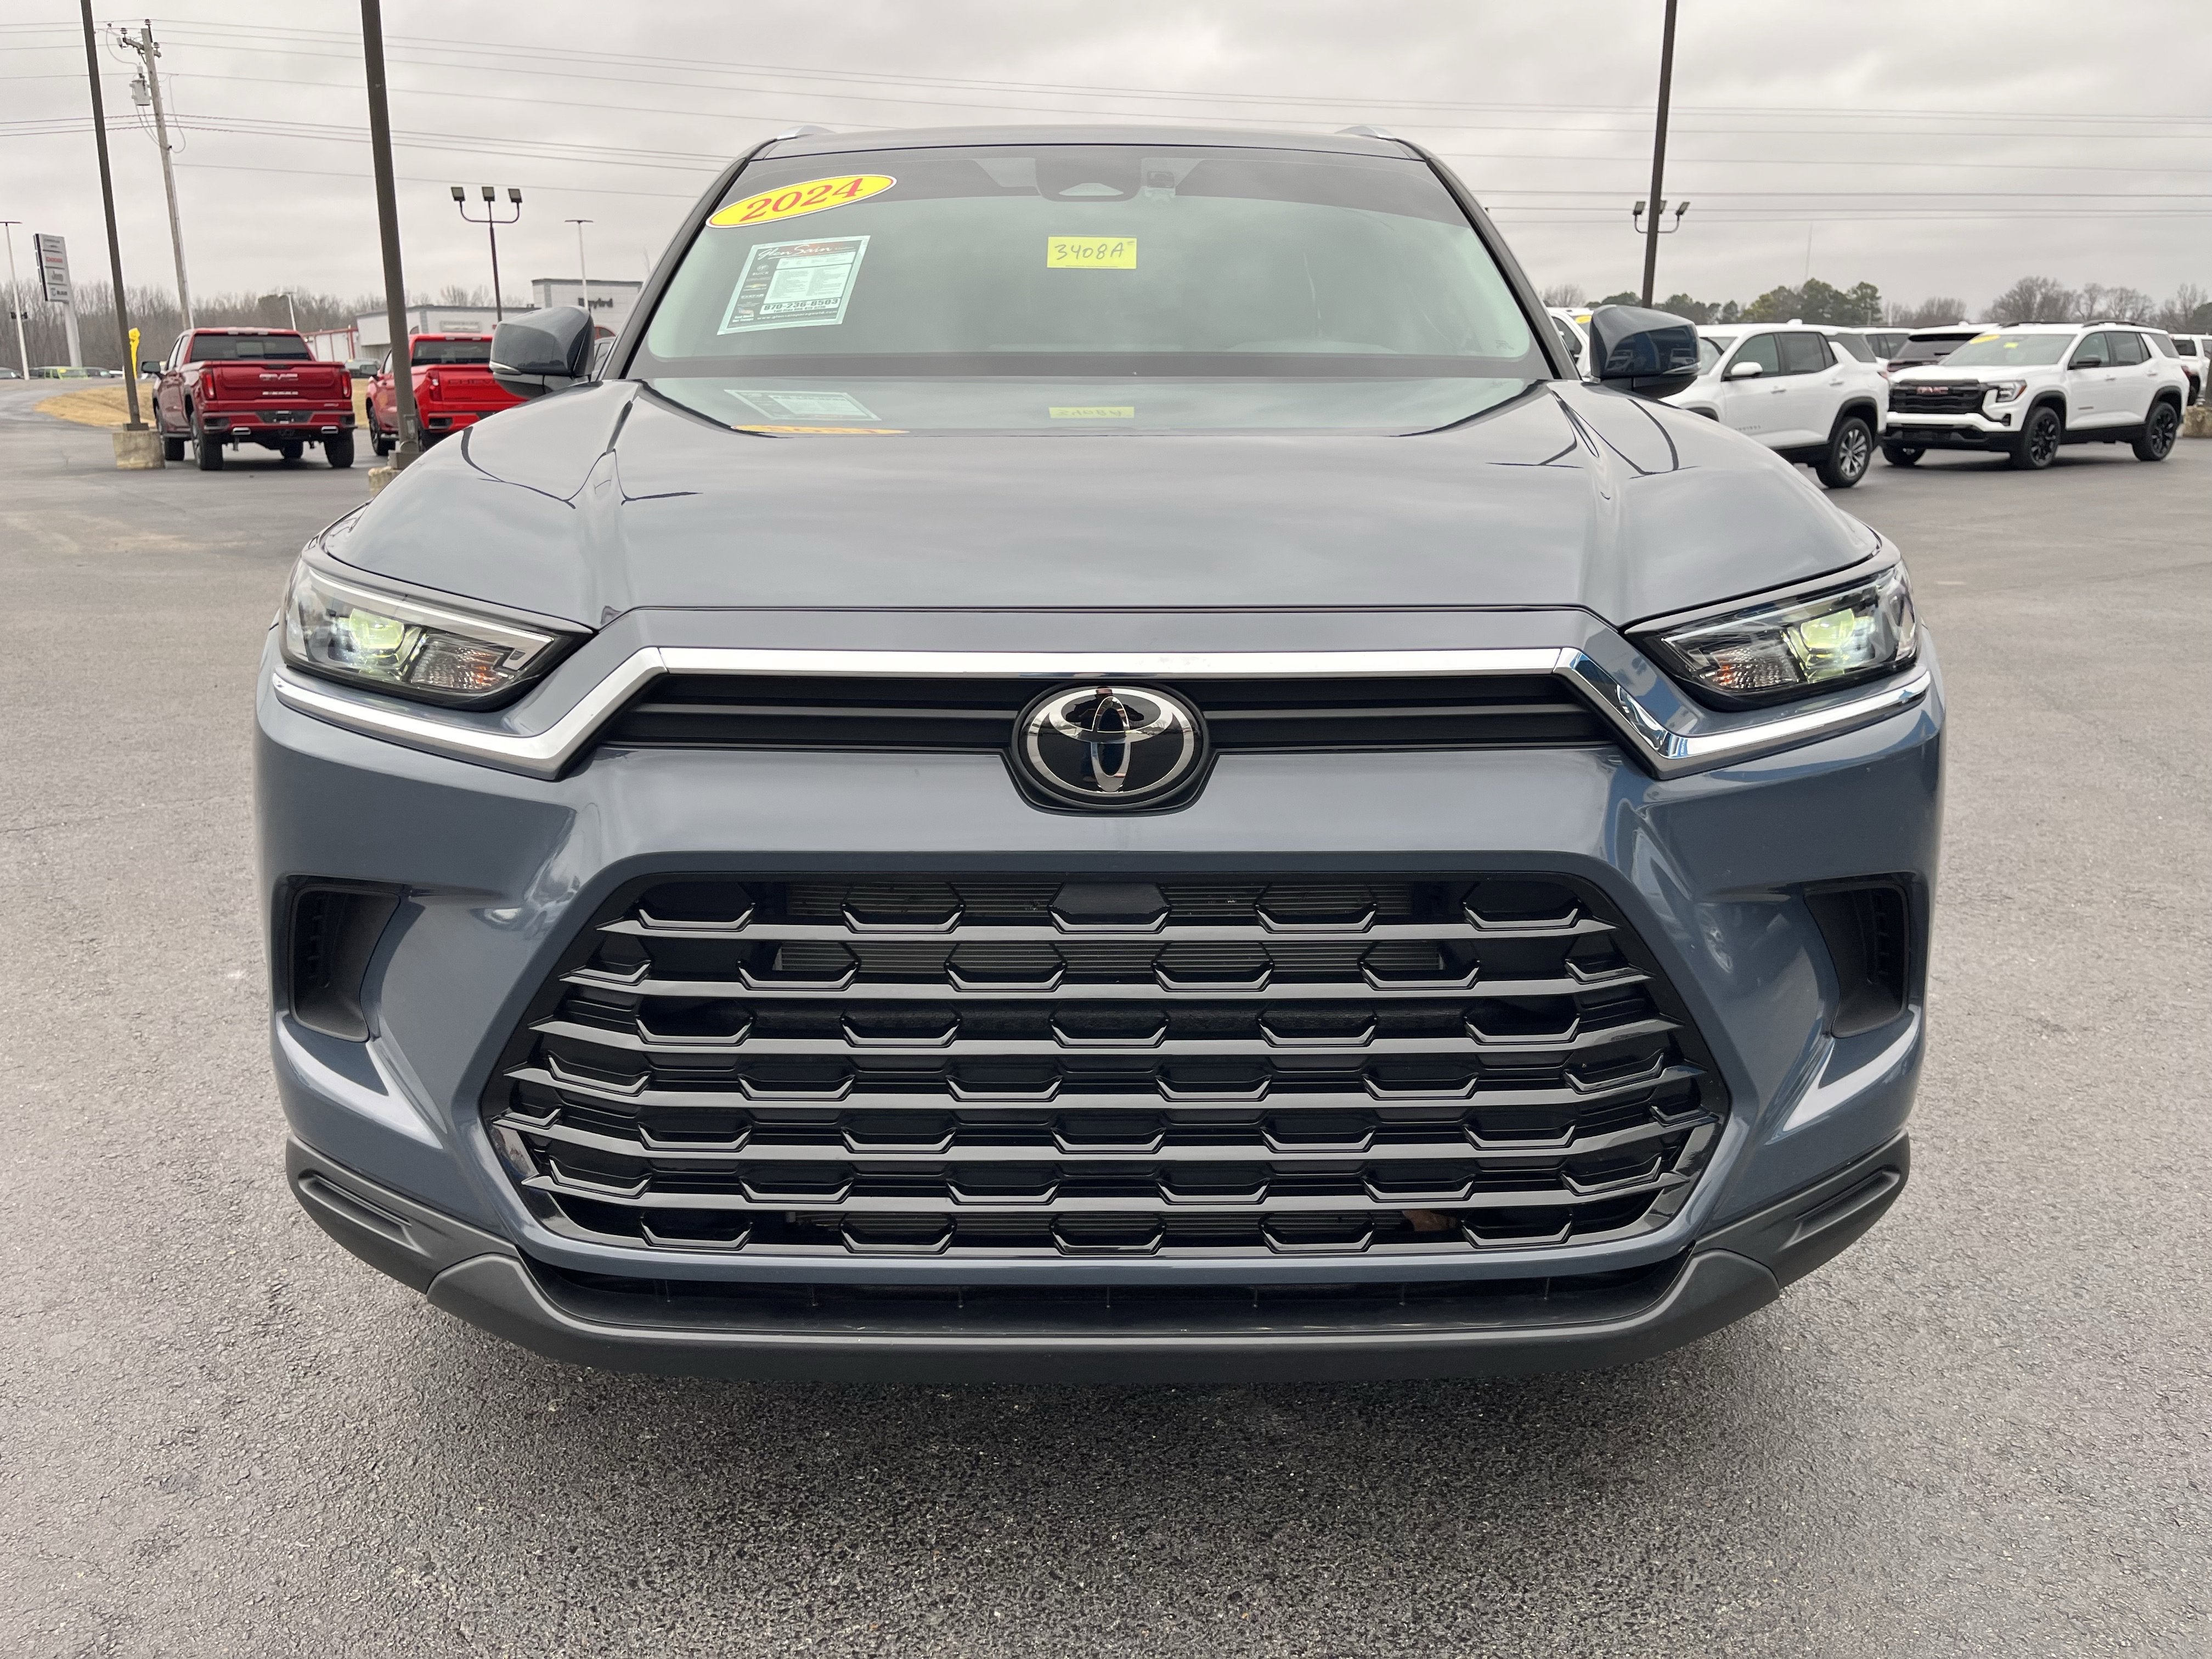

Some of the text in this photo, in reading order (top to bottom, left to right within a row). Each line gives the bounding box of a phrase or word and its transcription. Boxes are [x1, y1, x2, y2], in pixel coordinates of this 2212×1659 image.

[739, 178, 863, 222] 2024
[758, 247, 791, 261] Glen
[794, 244, 833, 255] Sain
[1054, 242, 1124, 260] 3408A
[764, 298, 839, 311] 870-236-8503
